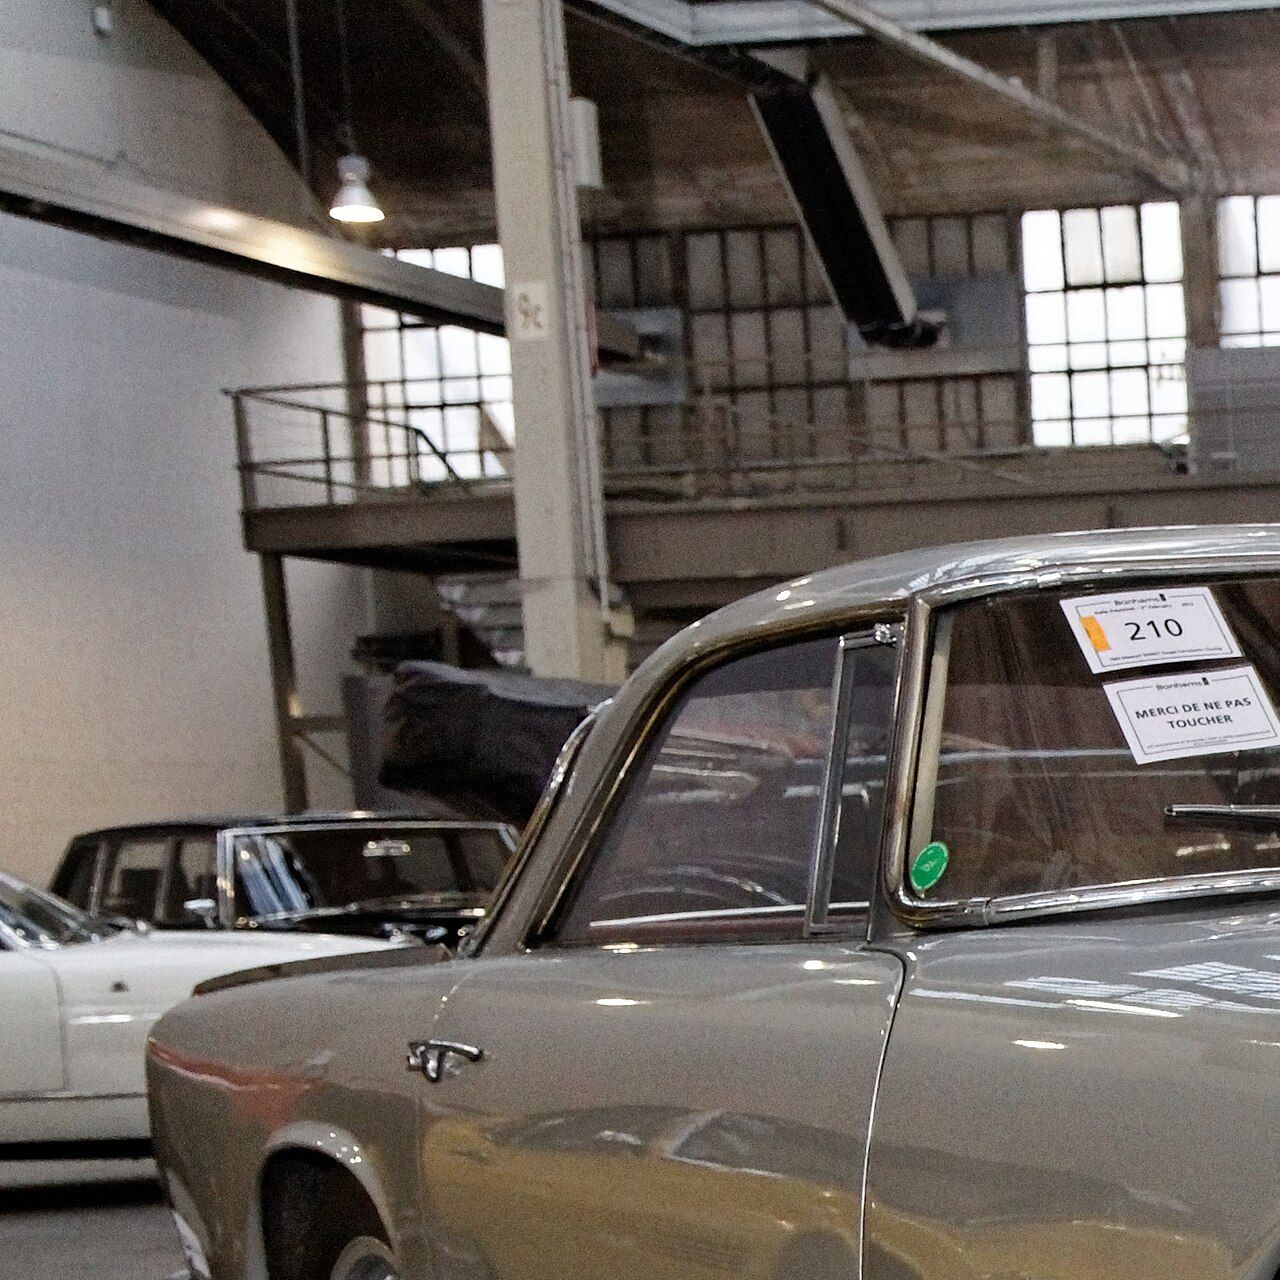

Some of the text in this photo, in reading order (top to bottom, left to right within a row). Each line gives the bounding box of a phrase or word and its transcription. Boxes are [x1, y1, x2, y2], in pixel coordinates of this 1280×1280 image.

[1125, 618, 1183, 641] 210
[1135, 697, 1251, 719] MERCI DE NE PAS
[1167, 714, 1233, 729] TOUCHER
